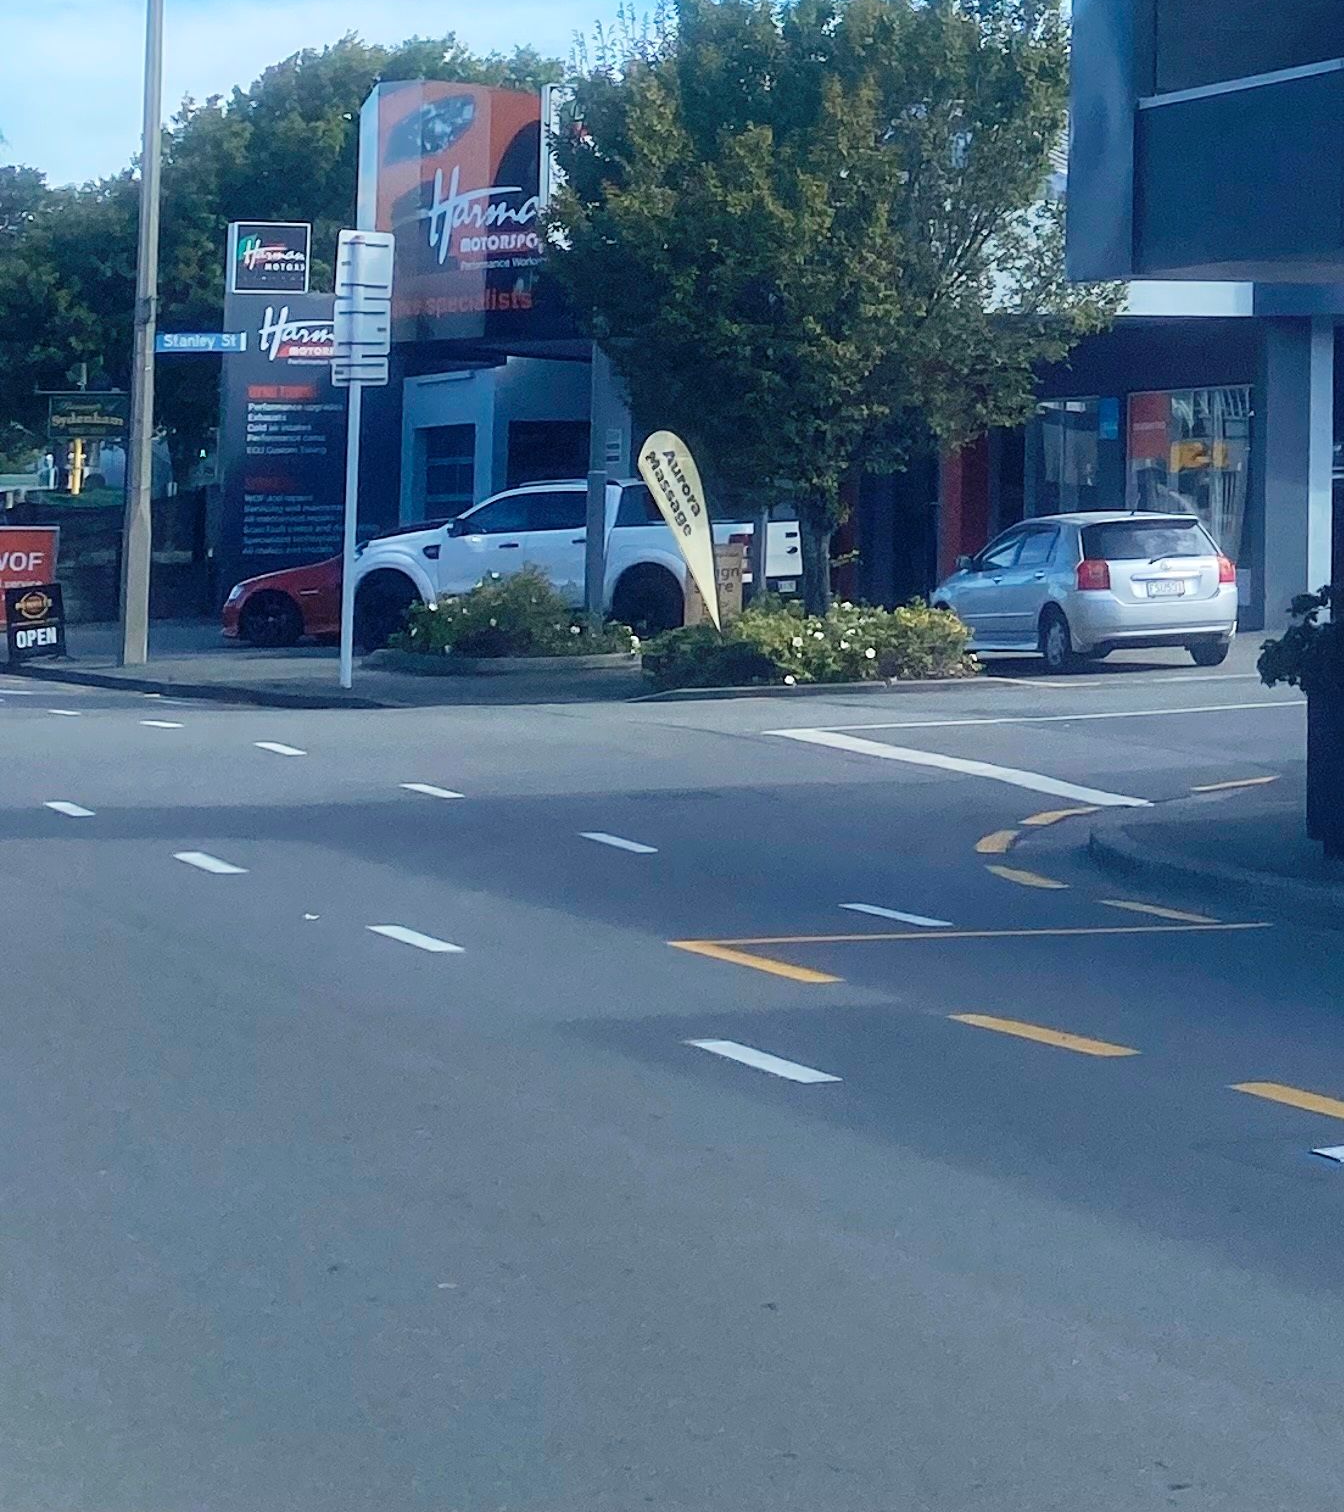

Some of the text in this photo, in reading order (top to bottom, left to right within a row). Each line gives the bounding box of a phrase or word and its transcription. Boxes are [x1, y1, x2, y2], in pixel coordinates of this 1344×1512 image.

[428, 165, 540, 265] Harma
[163, 333, 237, 351] Stanley St
[258, 306, 335, 361] Harm
[51, 411, 124, 430] Sydenham
[644, 450, 693, 538] Massage
[662, 449, 702, 518] Aurora
[16, 626, 57, 649] OPEN
